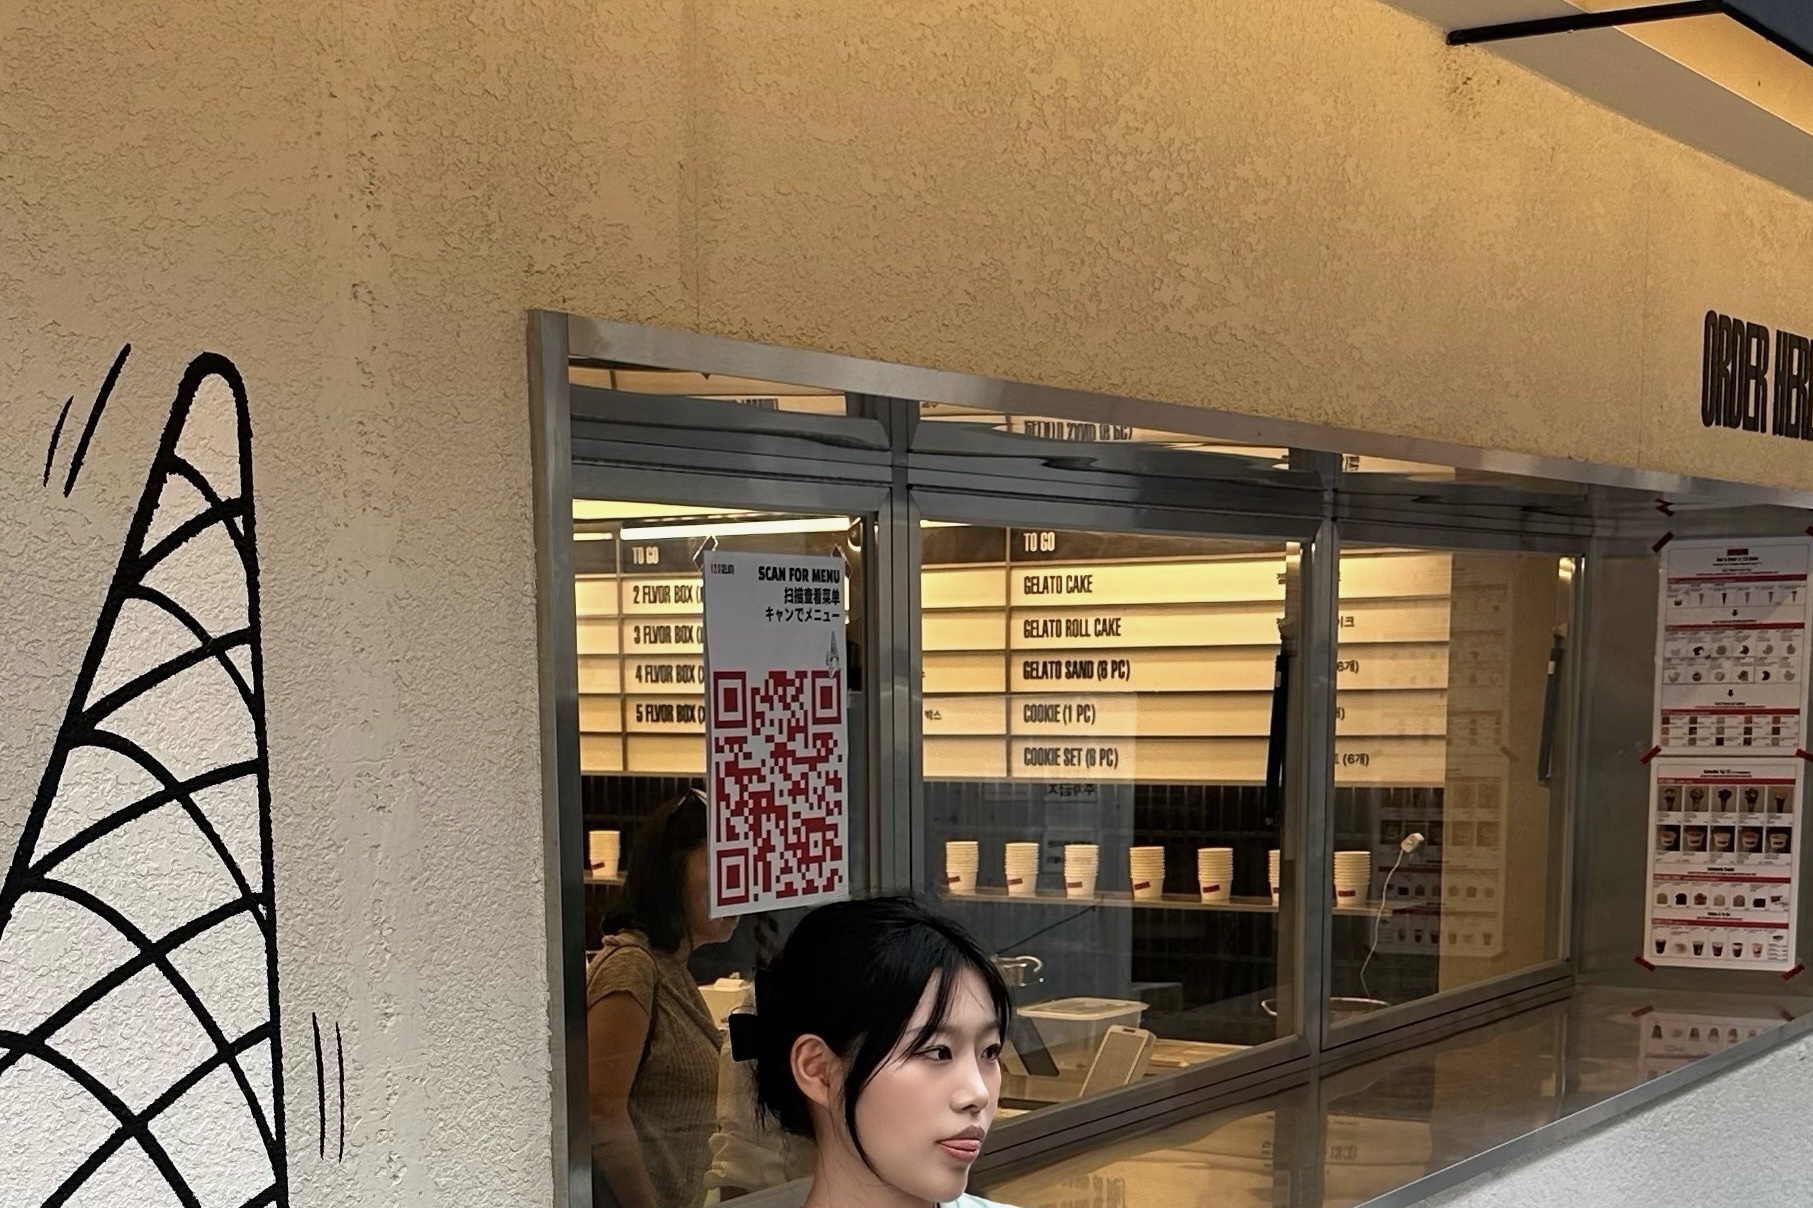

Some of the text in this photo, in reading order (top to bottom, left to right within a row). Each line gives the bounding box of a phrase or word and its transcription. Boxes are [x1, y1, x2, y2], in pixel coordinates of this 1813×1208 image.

[1702, 310, 1769, 433] ORDER
[1023, 531, 1056, 552] TO GO
[632, 546, 659, 565] TO GO
[758, 566, 840, 584] SCAN FOR MENU
[1024, 574, 1093, 595] GELATO CAKE
[633, 585, 640, 604] 2
[674, 585, 693, 604] BOX
[765, 606, 840, 622] キャンでメニュー
[634, 625, 641, 645] 3
[675, 625, 694, 644] BOX
[1023, 617, 1121, 639] GELATO ROLL CAKE
[635, 665, 642, 684] 4
[676, 665, 695, 684] BOX
[1023, 660, 1062, 680] GELATO
[1064, 660, 1094, 679] SAND
[1111, 659, 1131, 682] PC)
[636, 704, 643, 723] 5
[677, 704, 696, 723] BOX
[1023, 703, 1096, 726] COOKIE (1 PC)
[1024, 747, 1061, 767] COOKIE
[1063, 747, 1083, 766] SET
[1099, 747, 1119, 769] PC)
